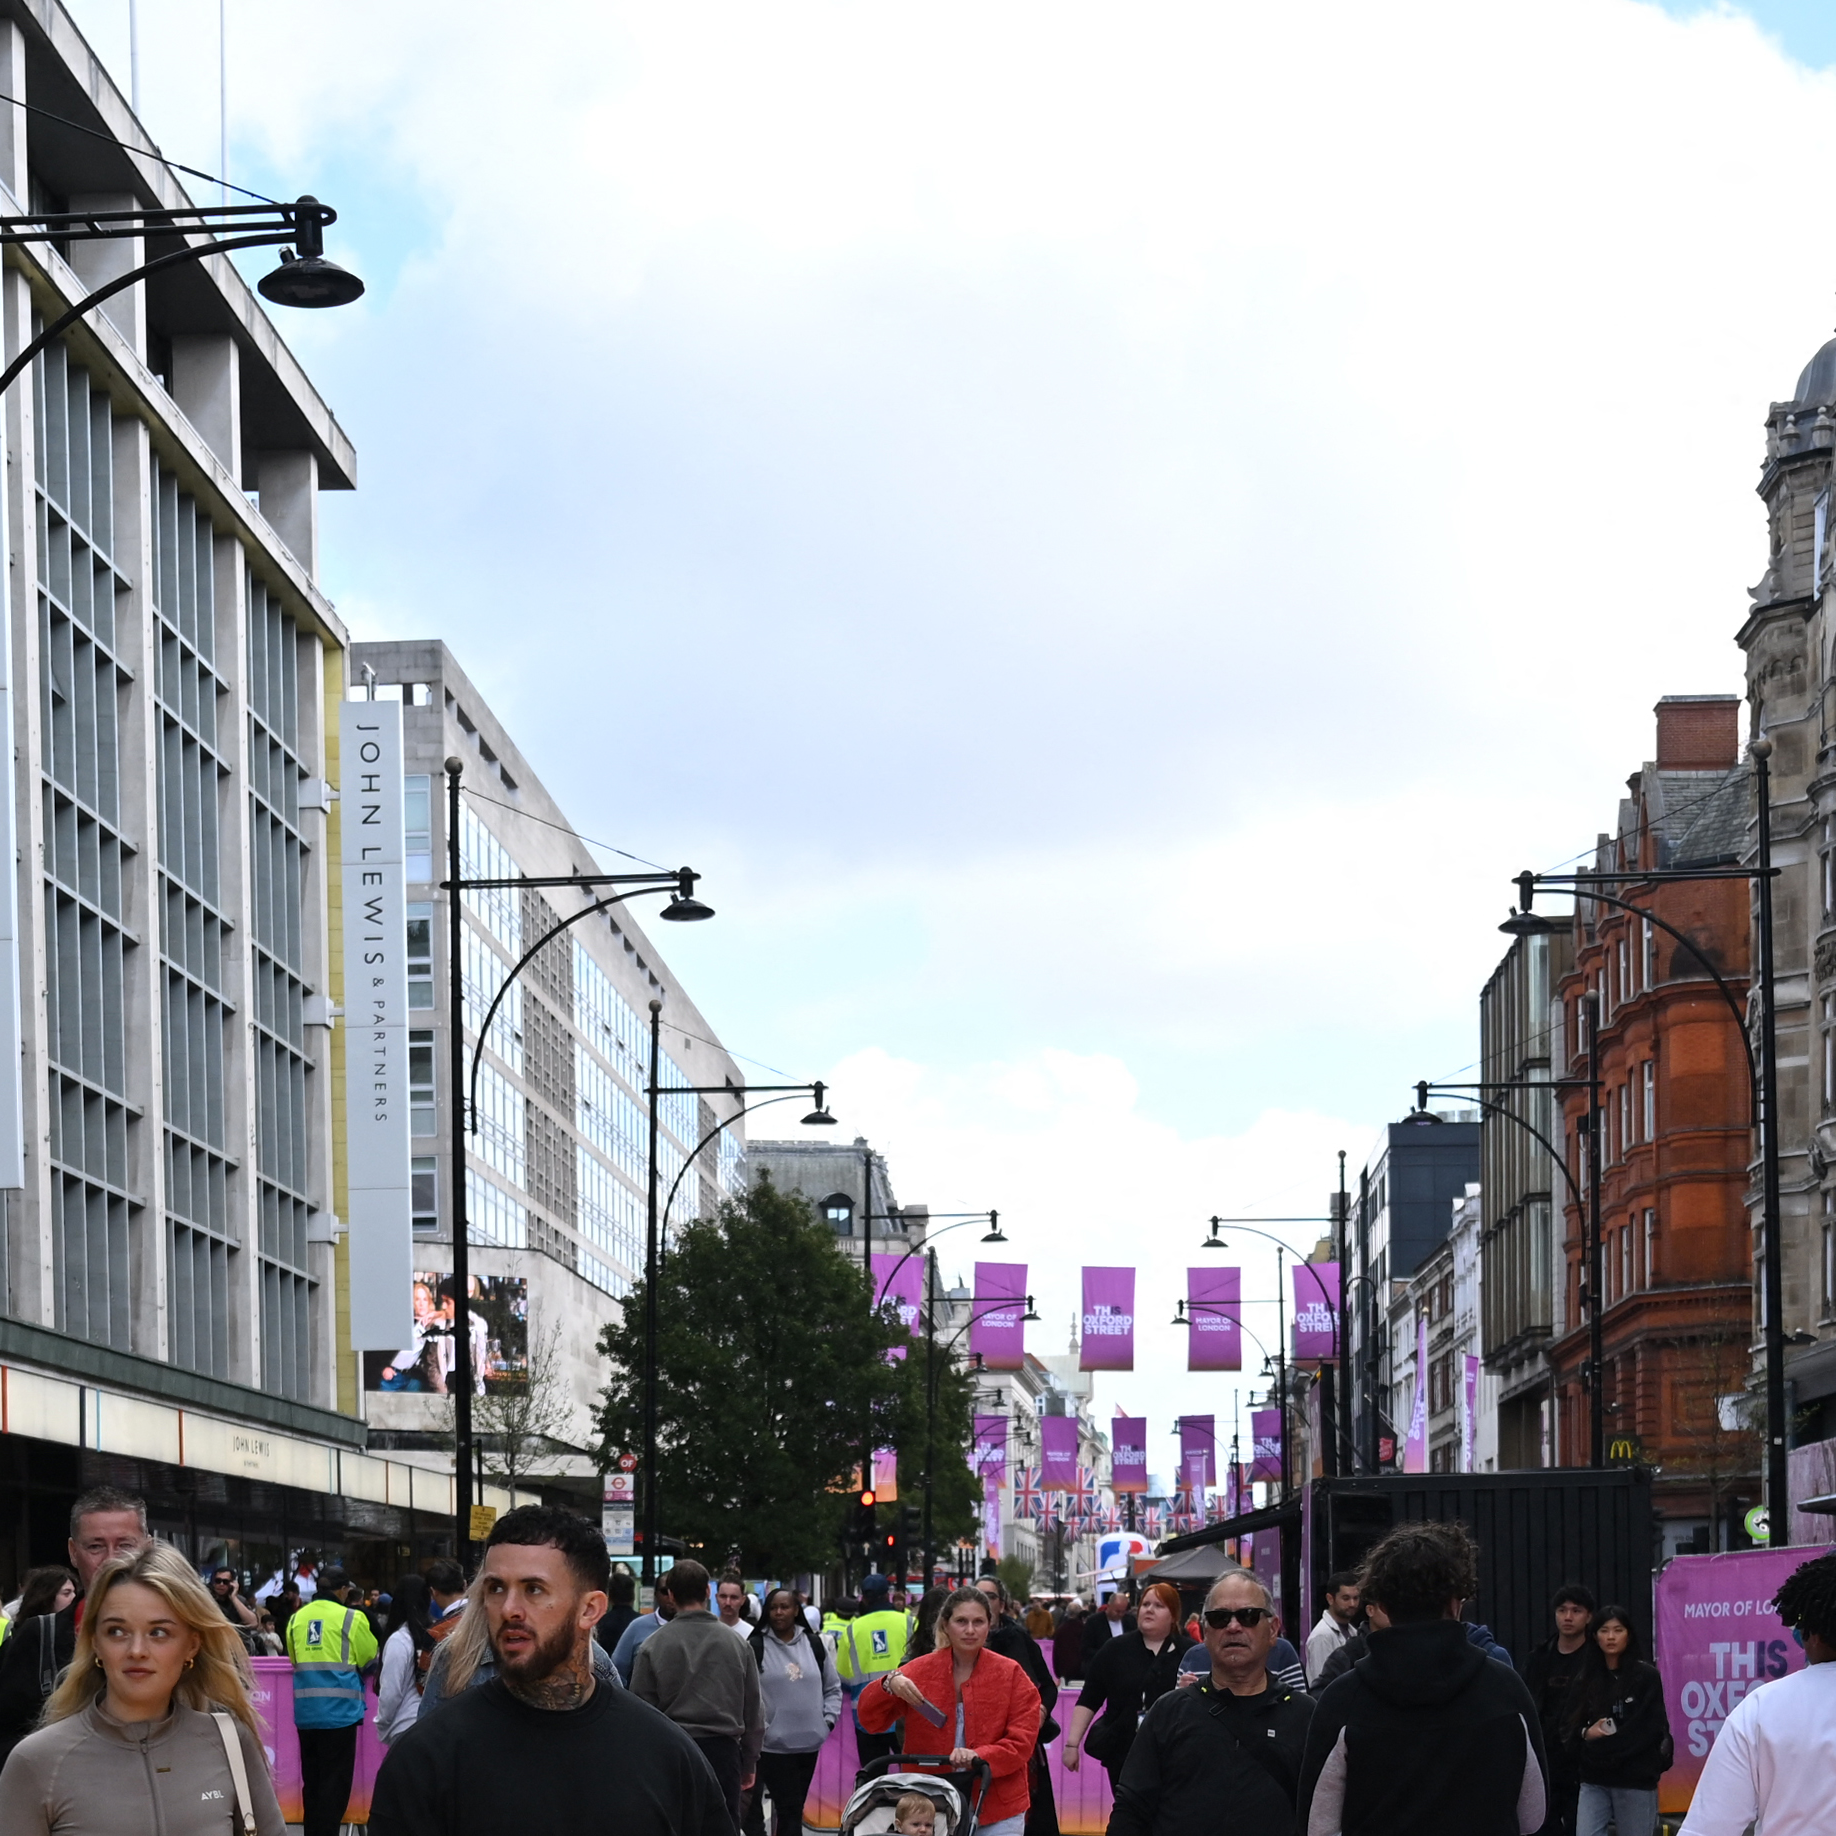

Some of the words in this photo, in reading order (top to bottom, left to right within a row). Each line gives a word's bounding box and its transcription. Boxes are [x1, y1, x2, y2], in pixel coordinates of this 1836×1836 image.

[356, 724, 380, 825] JOHN
[361, 847, 385, 966] LEWIS
[373, 1000, 387, 1123] PARTNERS
[982, 1320, 1014, 1328] LONDON
[1083, 1315, 1132, 1326] OXFORD
[1196, 1317, 1221, 1325] MAYOR
[1085, 1324, 1130, 1335] STREET
[1198, 1324, 1230, 1332] LONDON
[1113, 1451, 1146, 1459] OXFORD
[621, 1459, 634, 1468] OF
[1684, 1602, 1730, 1618] MAYOR
[1734, 1601, 1753, 1617] OF
[1709, 1640, 1787, 1678] THIS
[201, 1790, 224, 1801] AYBL
